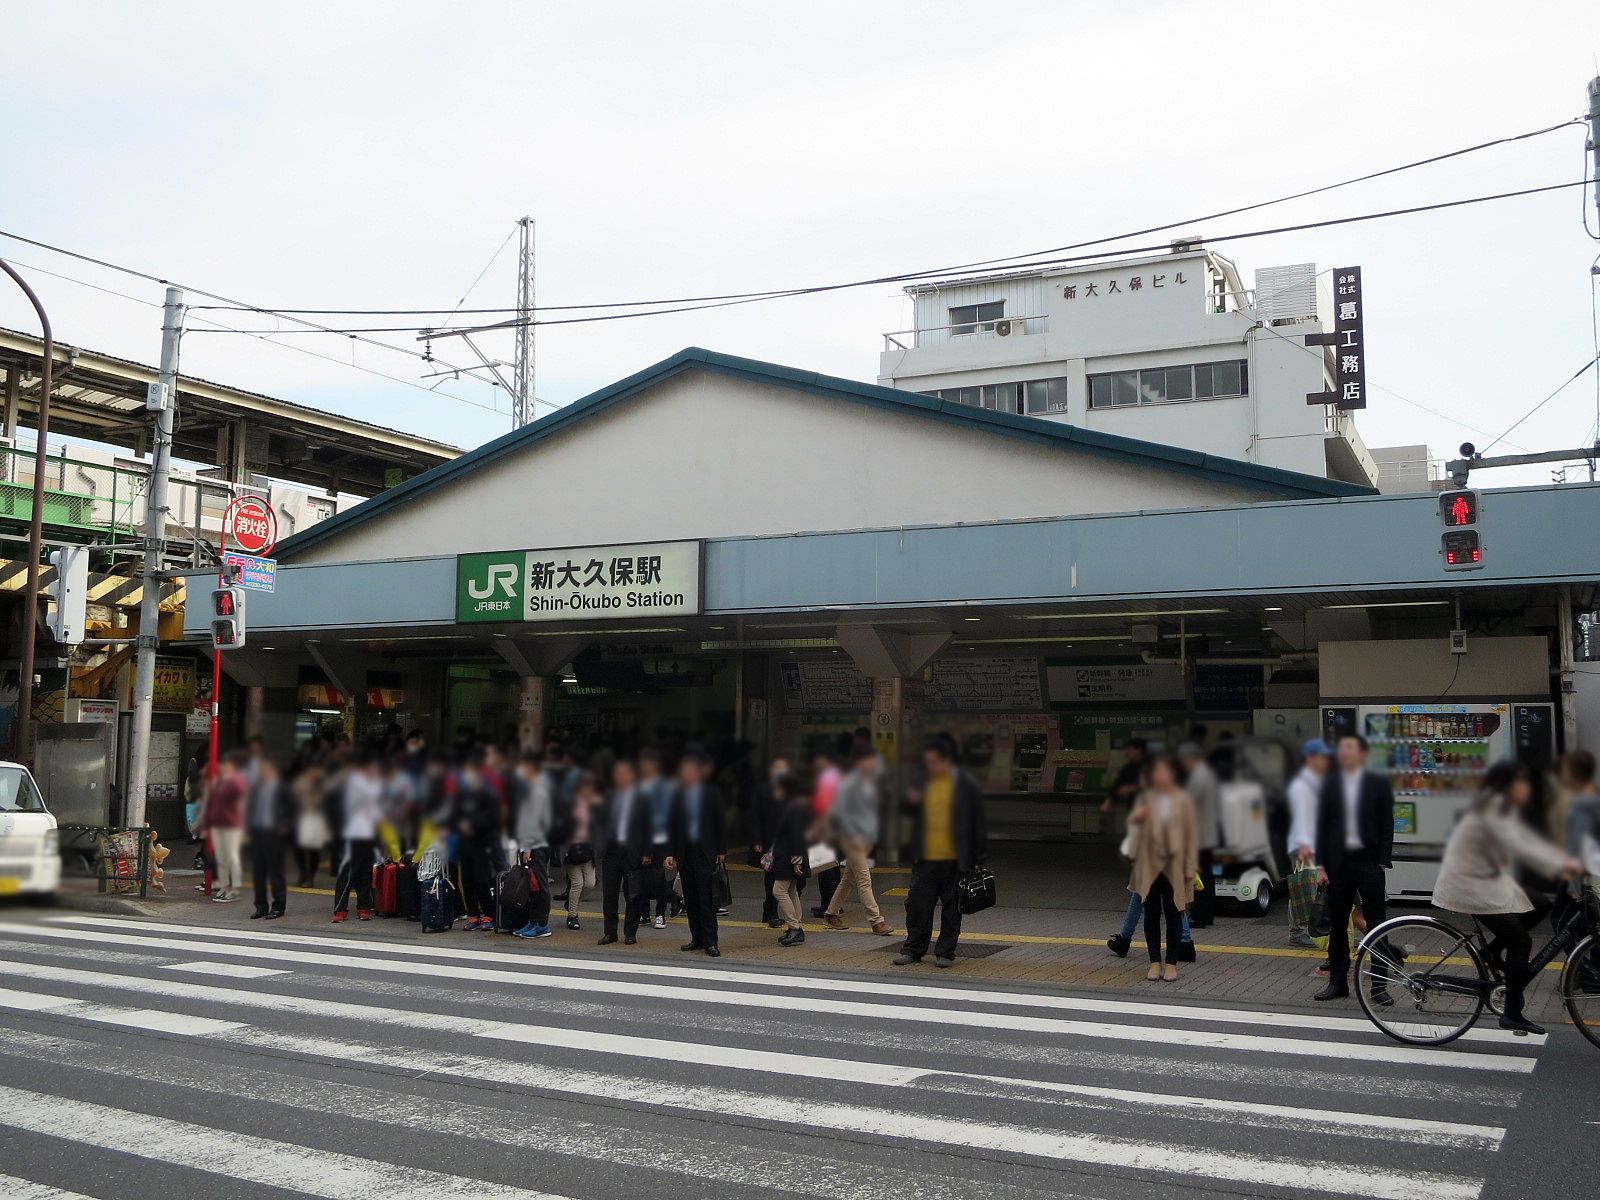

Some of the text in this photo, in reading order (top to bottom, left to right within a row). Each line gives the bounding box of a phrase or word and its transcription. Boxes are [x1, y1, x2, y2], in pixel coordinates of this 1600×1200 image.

[1063, 271, 1188, 299] 新大久保ビル
[1339, 301, 1361, 401] 葛工務店
[236, 516, 267, 538] 消火栓
[468, 563, 518, 599] JR
[531, 555, 661, 590] 新大久保駅
[474, 600, 511, 612] JR東日本
[530, 591, 684, 612] Shin-Ōkubo Station
